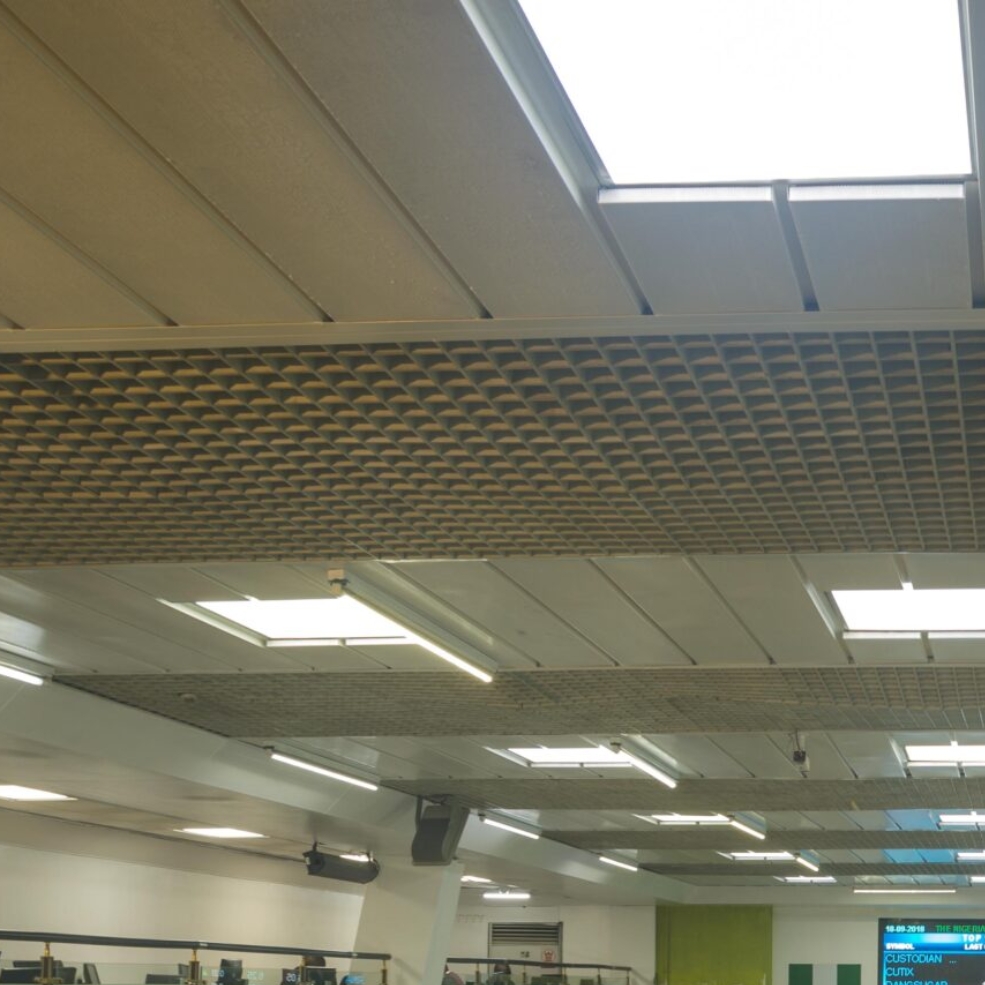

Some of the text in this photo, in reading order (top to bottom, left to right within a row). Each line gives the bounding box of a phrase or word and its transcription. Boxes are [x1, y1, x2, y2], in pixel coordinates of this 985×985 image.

[936, 925, 951, 933] THE
[963, 934, 982, 942] TOP
[964, 943, 983, 951] LAST
[885, 954, 943, 963] CUSTODIAN
[885, 967, 914, 976] CUTIX
